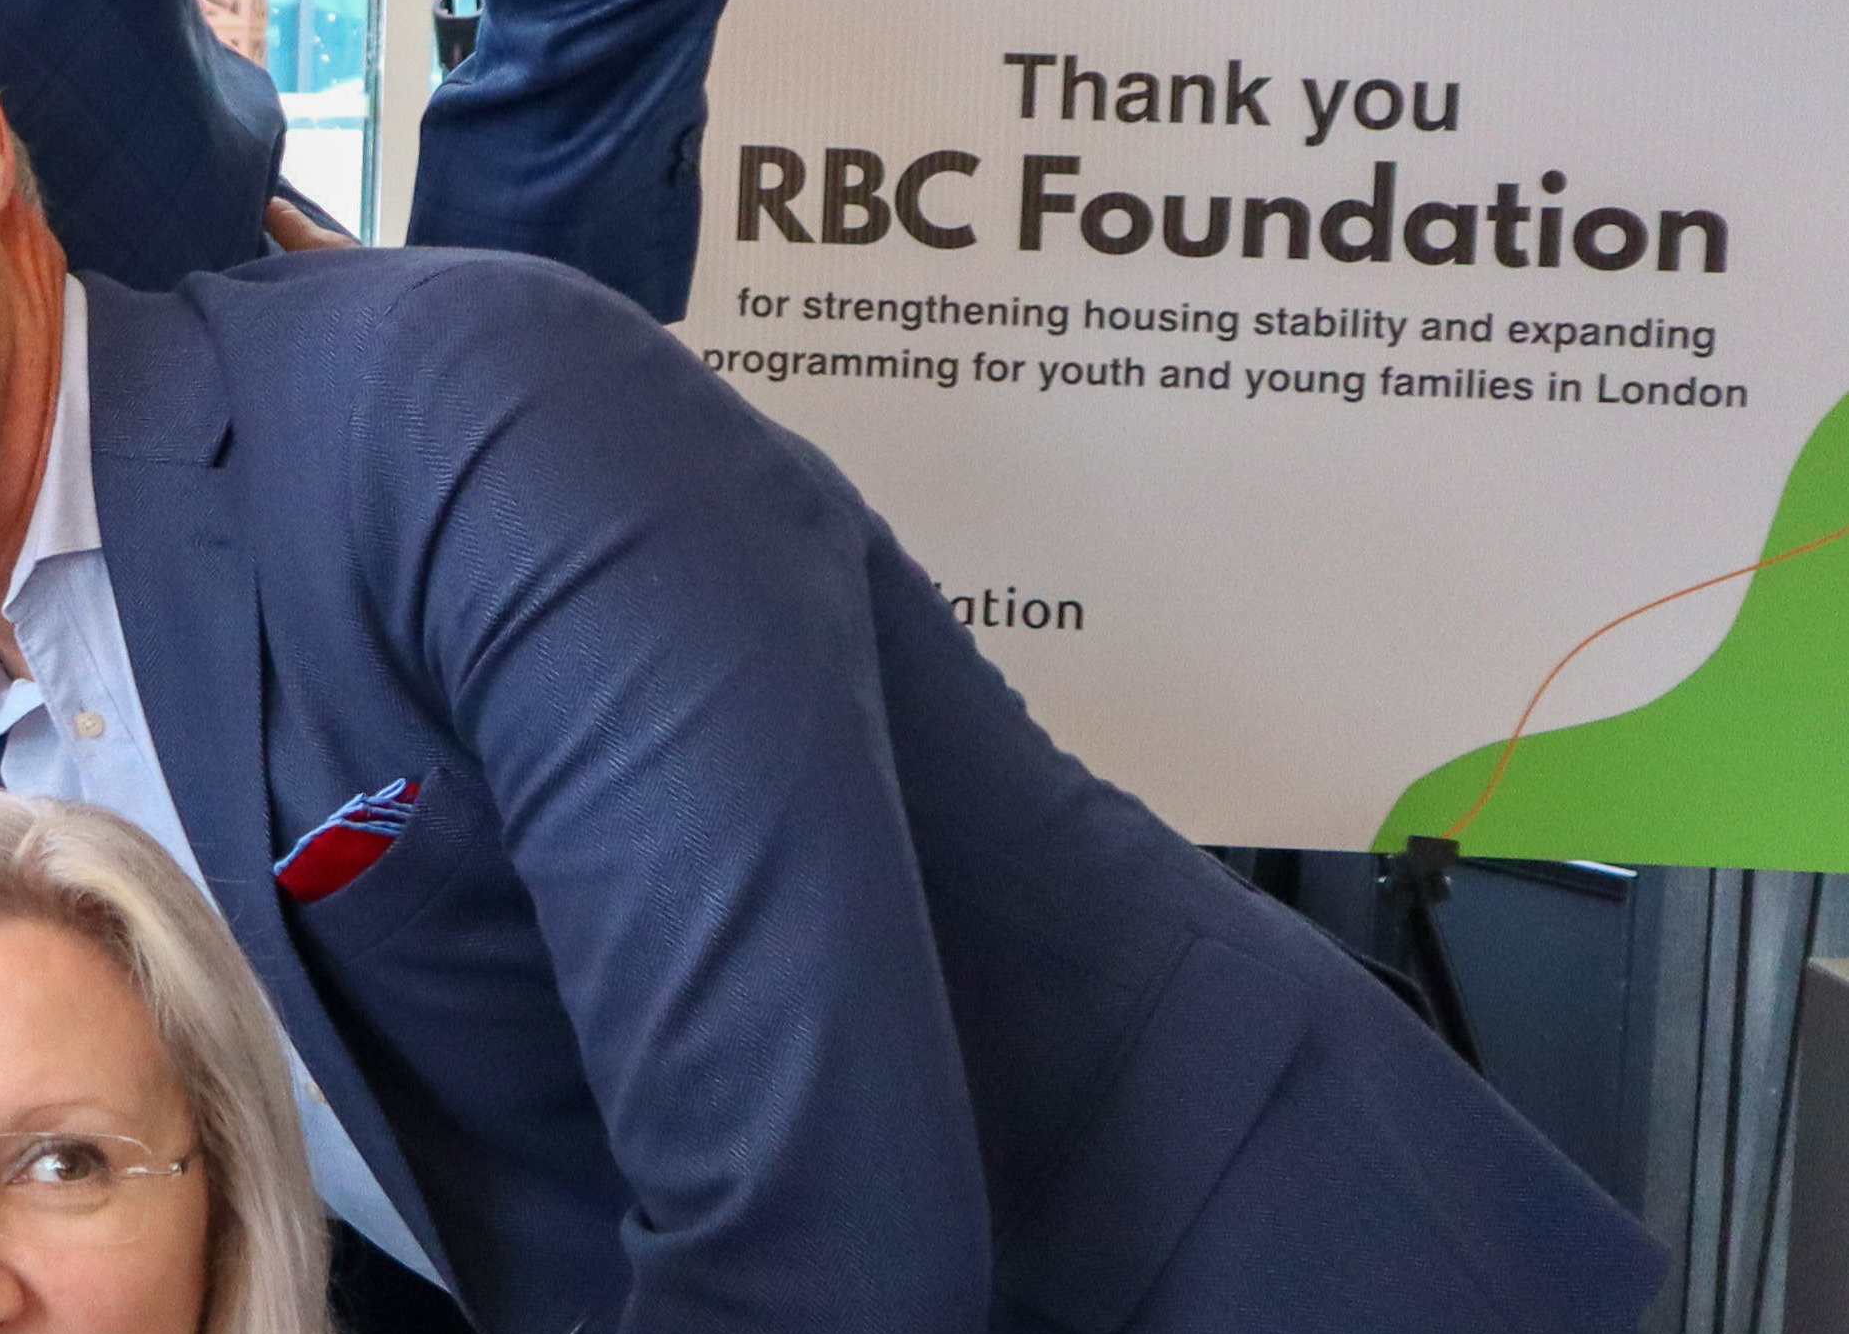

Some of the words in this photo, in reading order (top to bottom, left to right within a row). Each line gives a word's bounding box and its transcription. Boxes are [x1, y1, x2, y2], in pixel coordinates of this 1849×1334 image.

[1003, 52, 1272, 126] Thank
[1301, 77, 1460, 147] you
[736, 144, 982, 250] RBC
[1019, 153, 1729, 273] Foundation
[737, 286, 791, 319] for
[802, 291, 1070, 336] strengthening
[1084, 299, 1240, 342] housing
[1253, 306, 1408, 348] stability
[1420, 312, 1494, 343] and
[1507, 317, 1717, 358] expanding
[703, 347, 960, 388] programming
[972, 351, 1027, 383] for
[1038, 355, 1146, 393] youth
[1159, 360, 1231, 391] and
[1244, 367, 1366, 404] young
[1379, 365, 1534, 402] families
[1547, 371, 1582, 403] in
[1597, 372, 1749, 408] London
[934, 581, 1084, 631] ation
